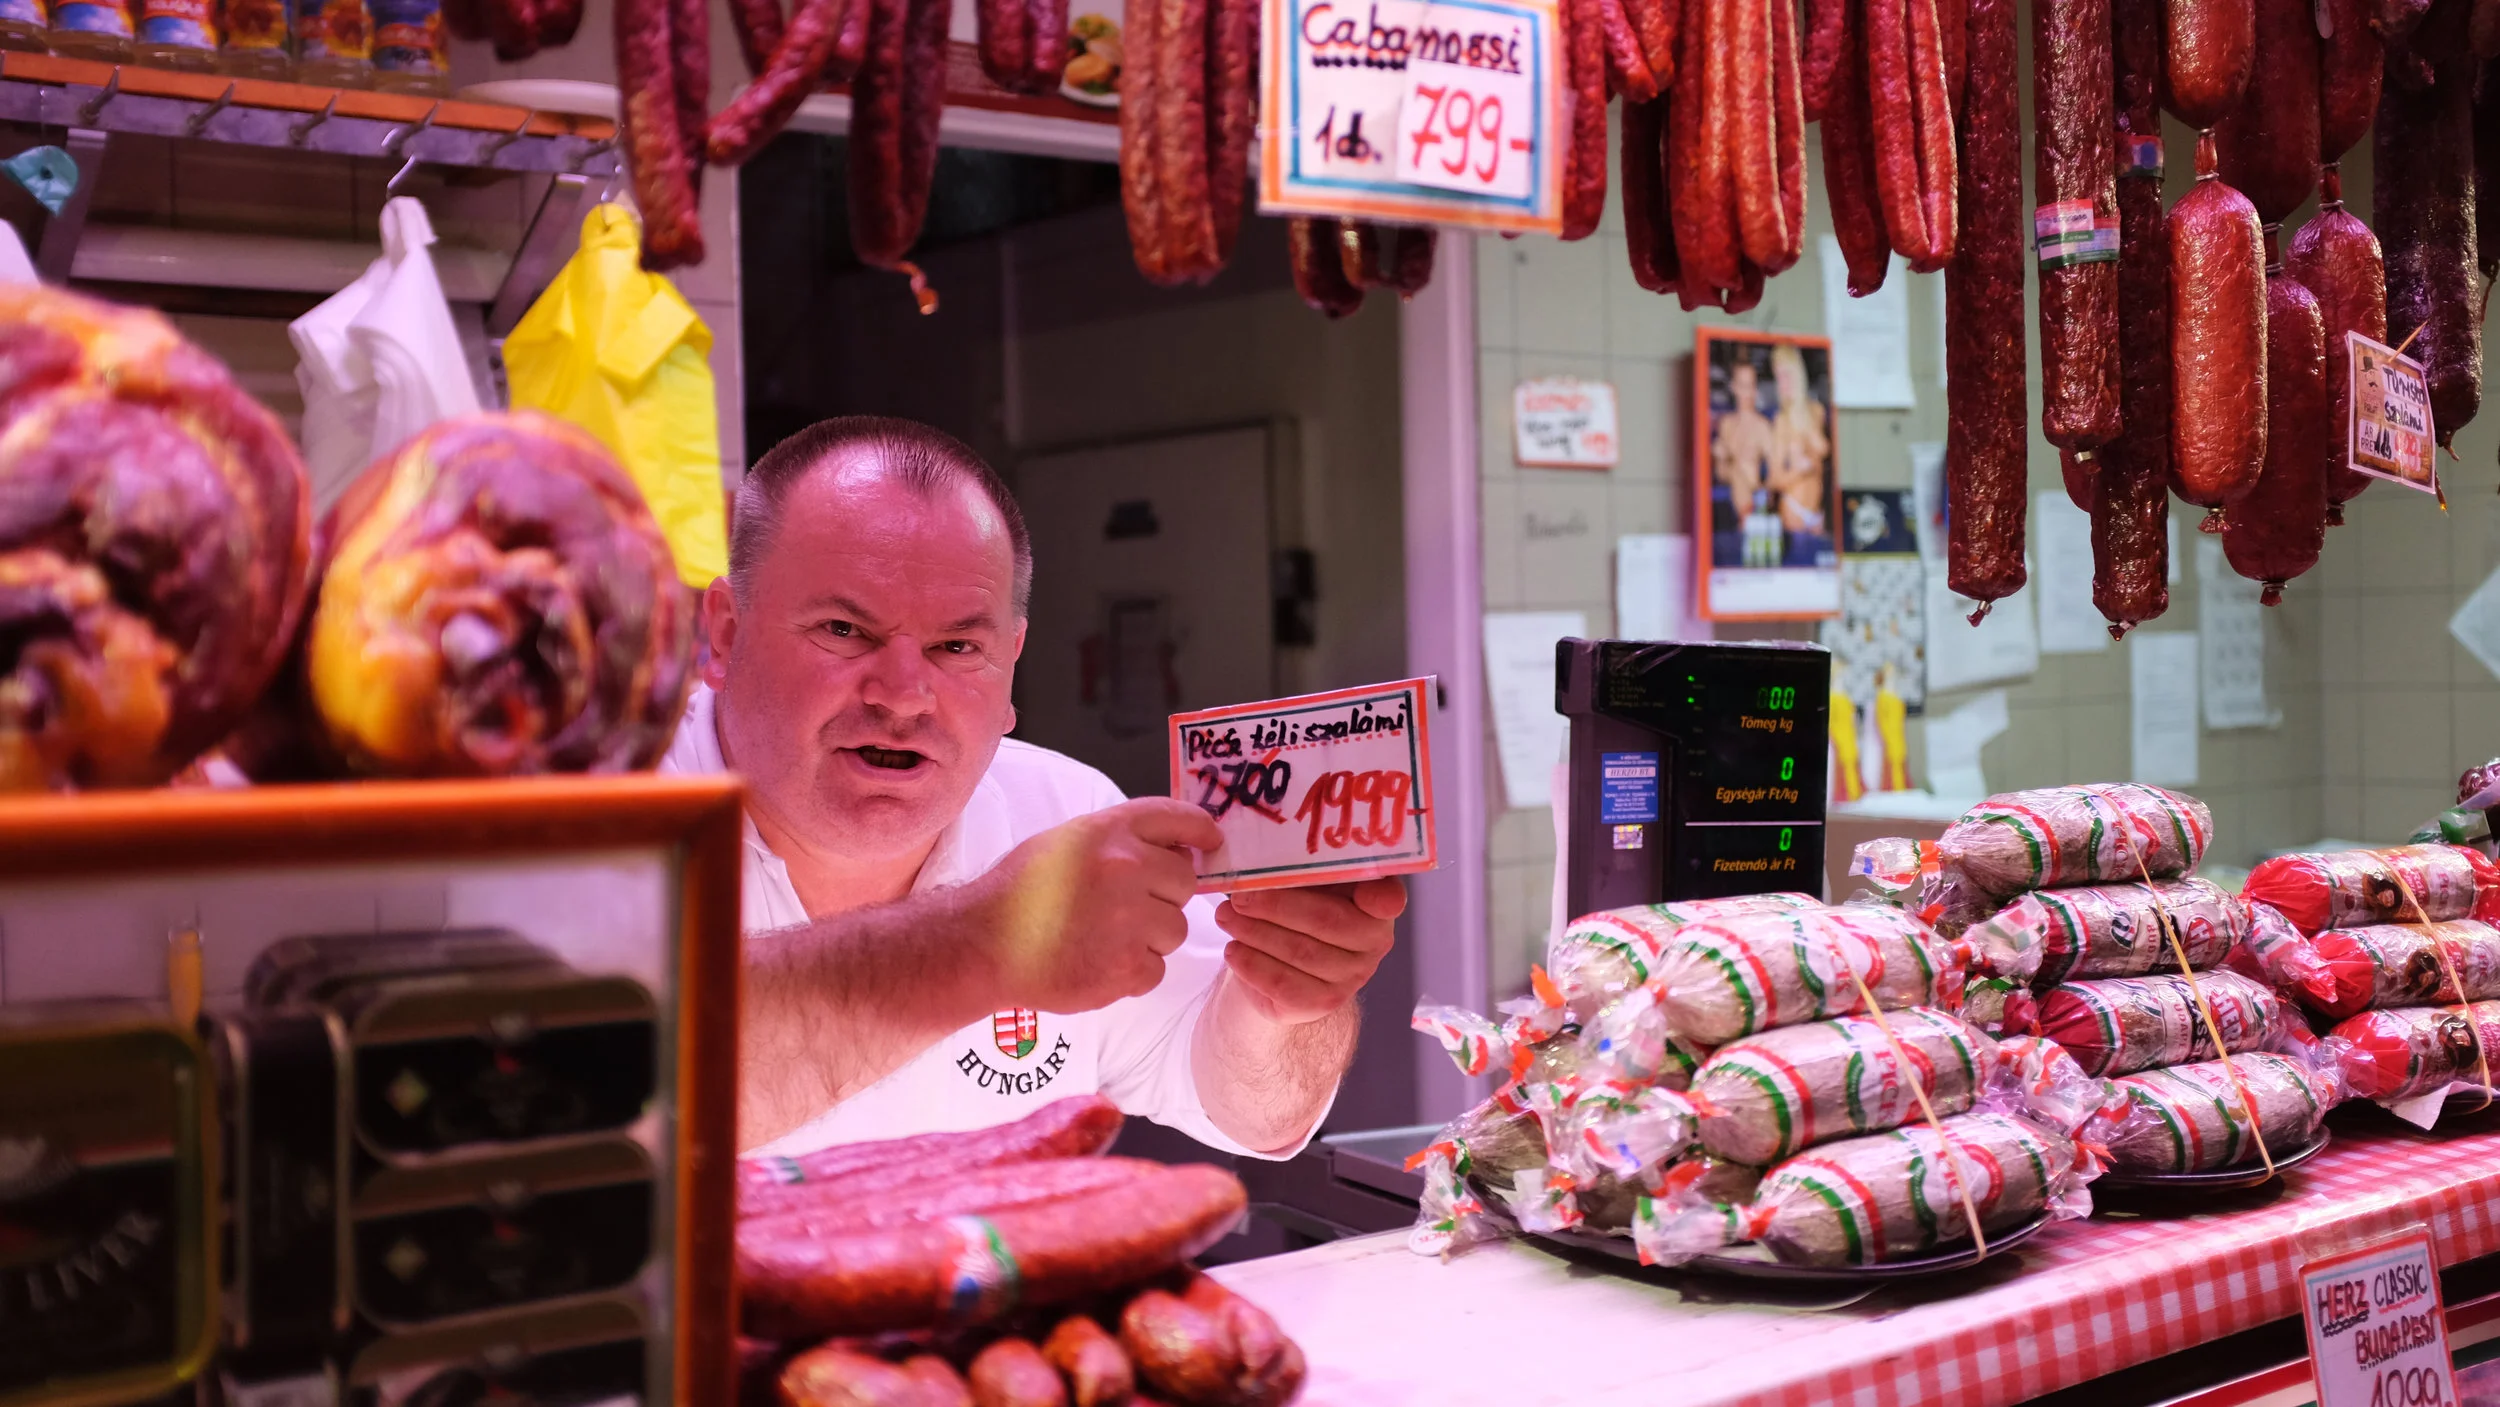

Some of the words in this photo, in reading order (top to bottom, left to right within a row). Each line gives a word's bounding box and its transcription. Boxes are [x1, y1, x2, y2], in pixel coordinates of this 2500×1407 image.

[1303, 3, 1521, 67] Cabanossi
[1250, 718, 1300, 750] téli
[1303, 702, 1408, 743] szalámi
[1740, 715, 1777, 733] Tömeg
[1779, 715, 1794, 733] kg
[1780, 756, 1794, 781] 0
[1715, 786, 1767, 807] Egységár
[1768, 787, 1799, 807] Ft/kg
[1779, 827, 1792, 851] 0
[1770, 857, 1783, 871] ár
[1784, 857, 1796, 871] Ft
[956, 1033, 1071, 1096] HUNGARY
[1873, 1050, 1900, 1125] PICK
[2317, 1279, 2371, 1328] HERZ
[2373, 1263, 2428, 1307] CLASSIC
[2355, 1306, 2438, 1365] BUDAPEST
